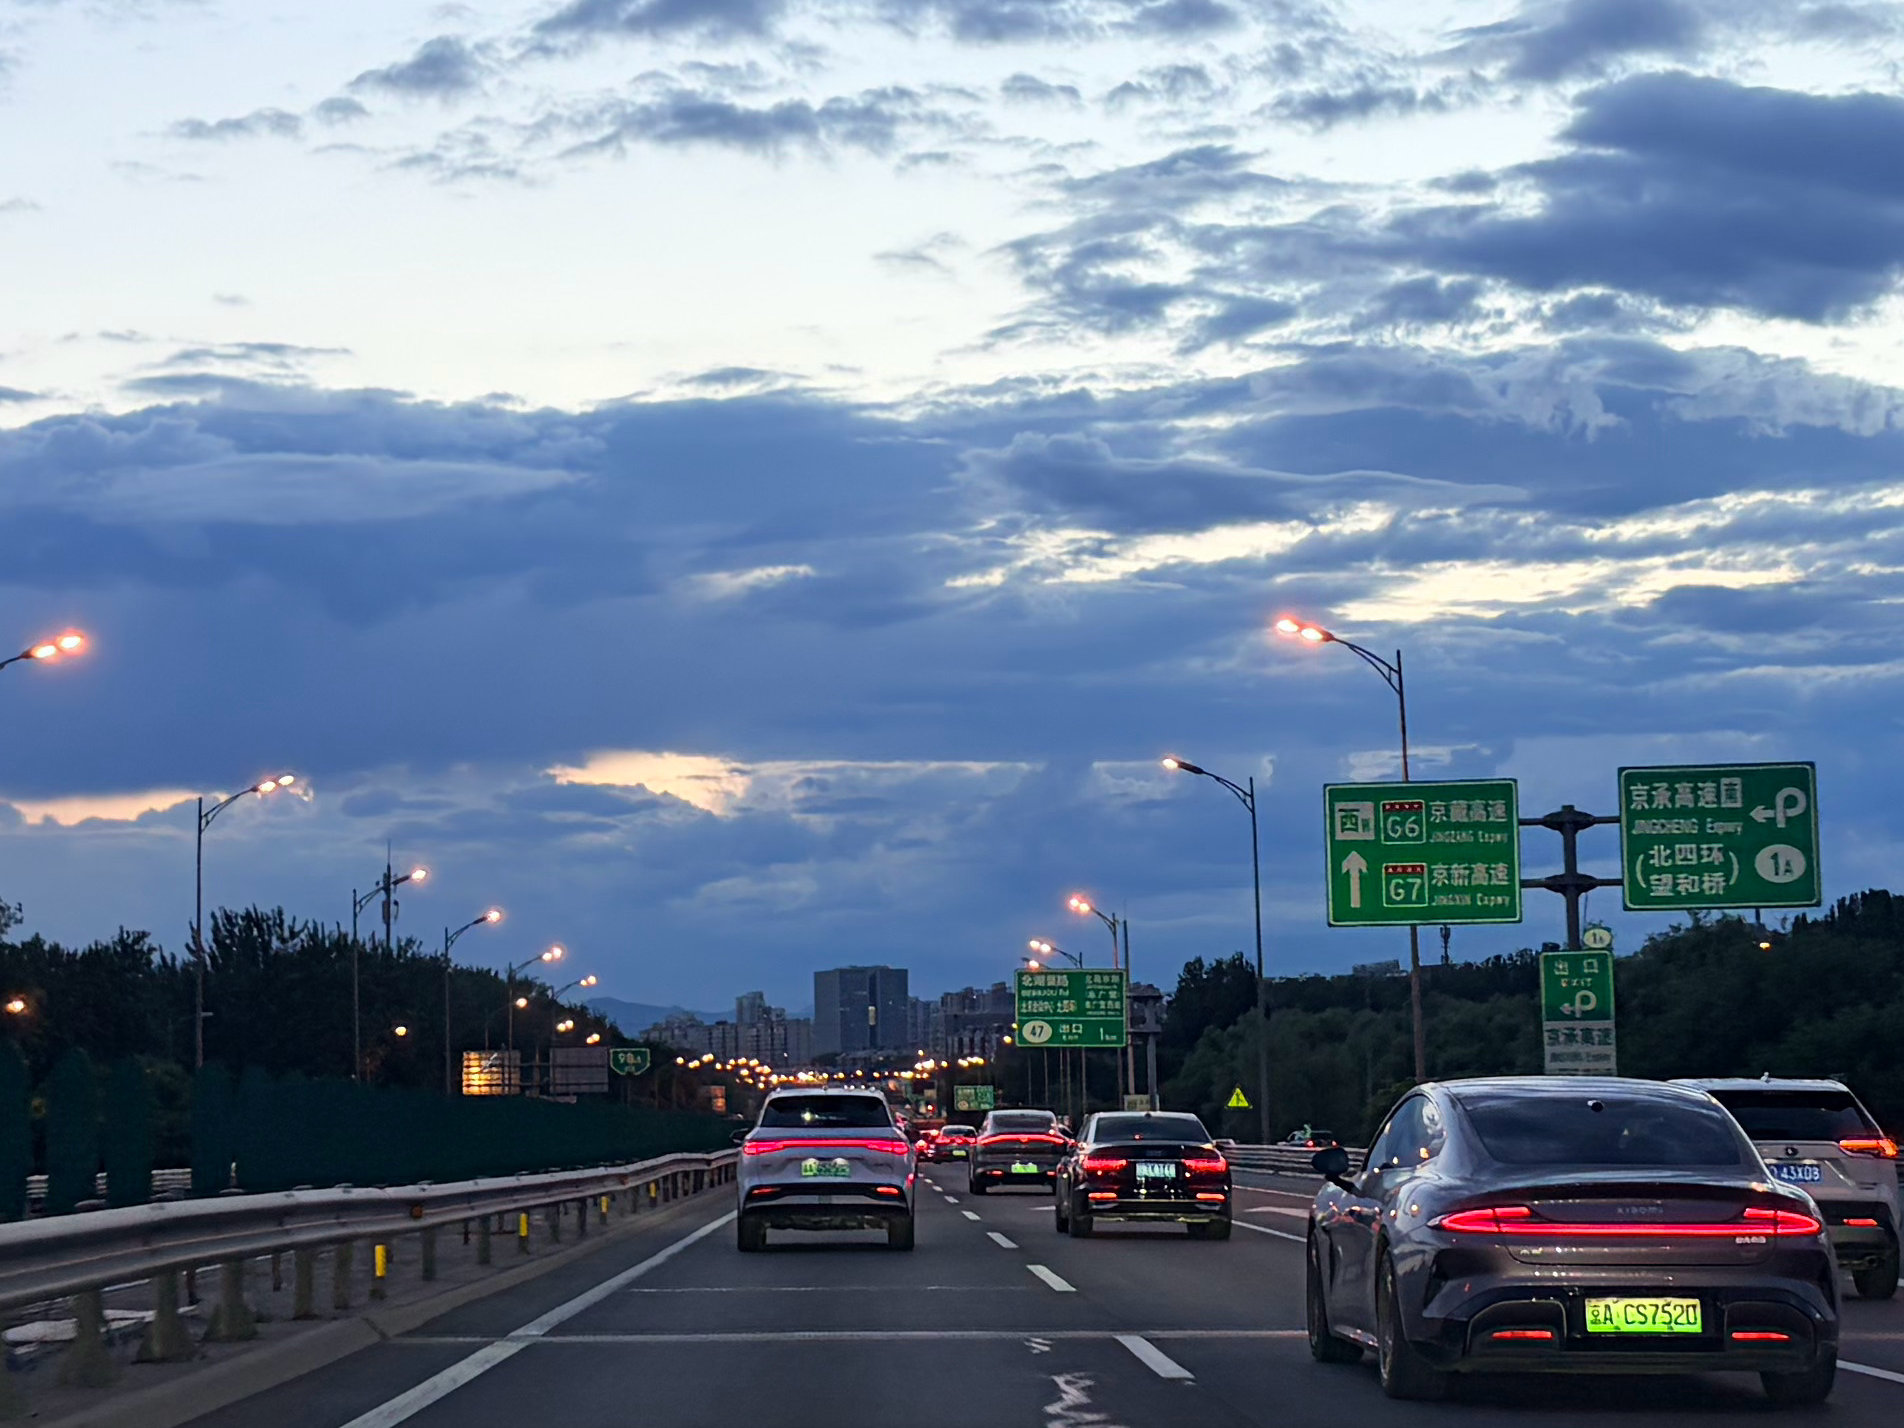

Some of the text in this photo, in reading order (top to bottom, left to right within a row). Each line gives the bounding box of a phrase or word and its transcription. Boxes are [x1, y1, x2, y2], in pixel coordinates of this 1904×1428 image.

[1629, 782, 1718, 810] 京承高速
[1429, 800, 1508, 823] 京藏高速
[1386, 816, 1420, 839] G6
[1648, 844, 1724, 867] 北四环
[1770, 852, 1794, 876] 1A
[1431, 862, 1510, 887] 京新高速
[1649, 872, 1726, 896] 望和桥
[1389, 878, 1422, 901] G7
[1554, 959, 1599, 975] 出口
[1030, 1025, 1044, 1037] 47
